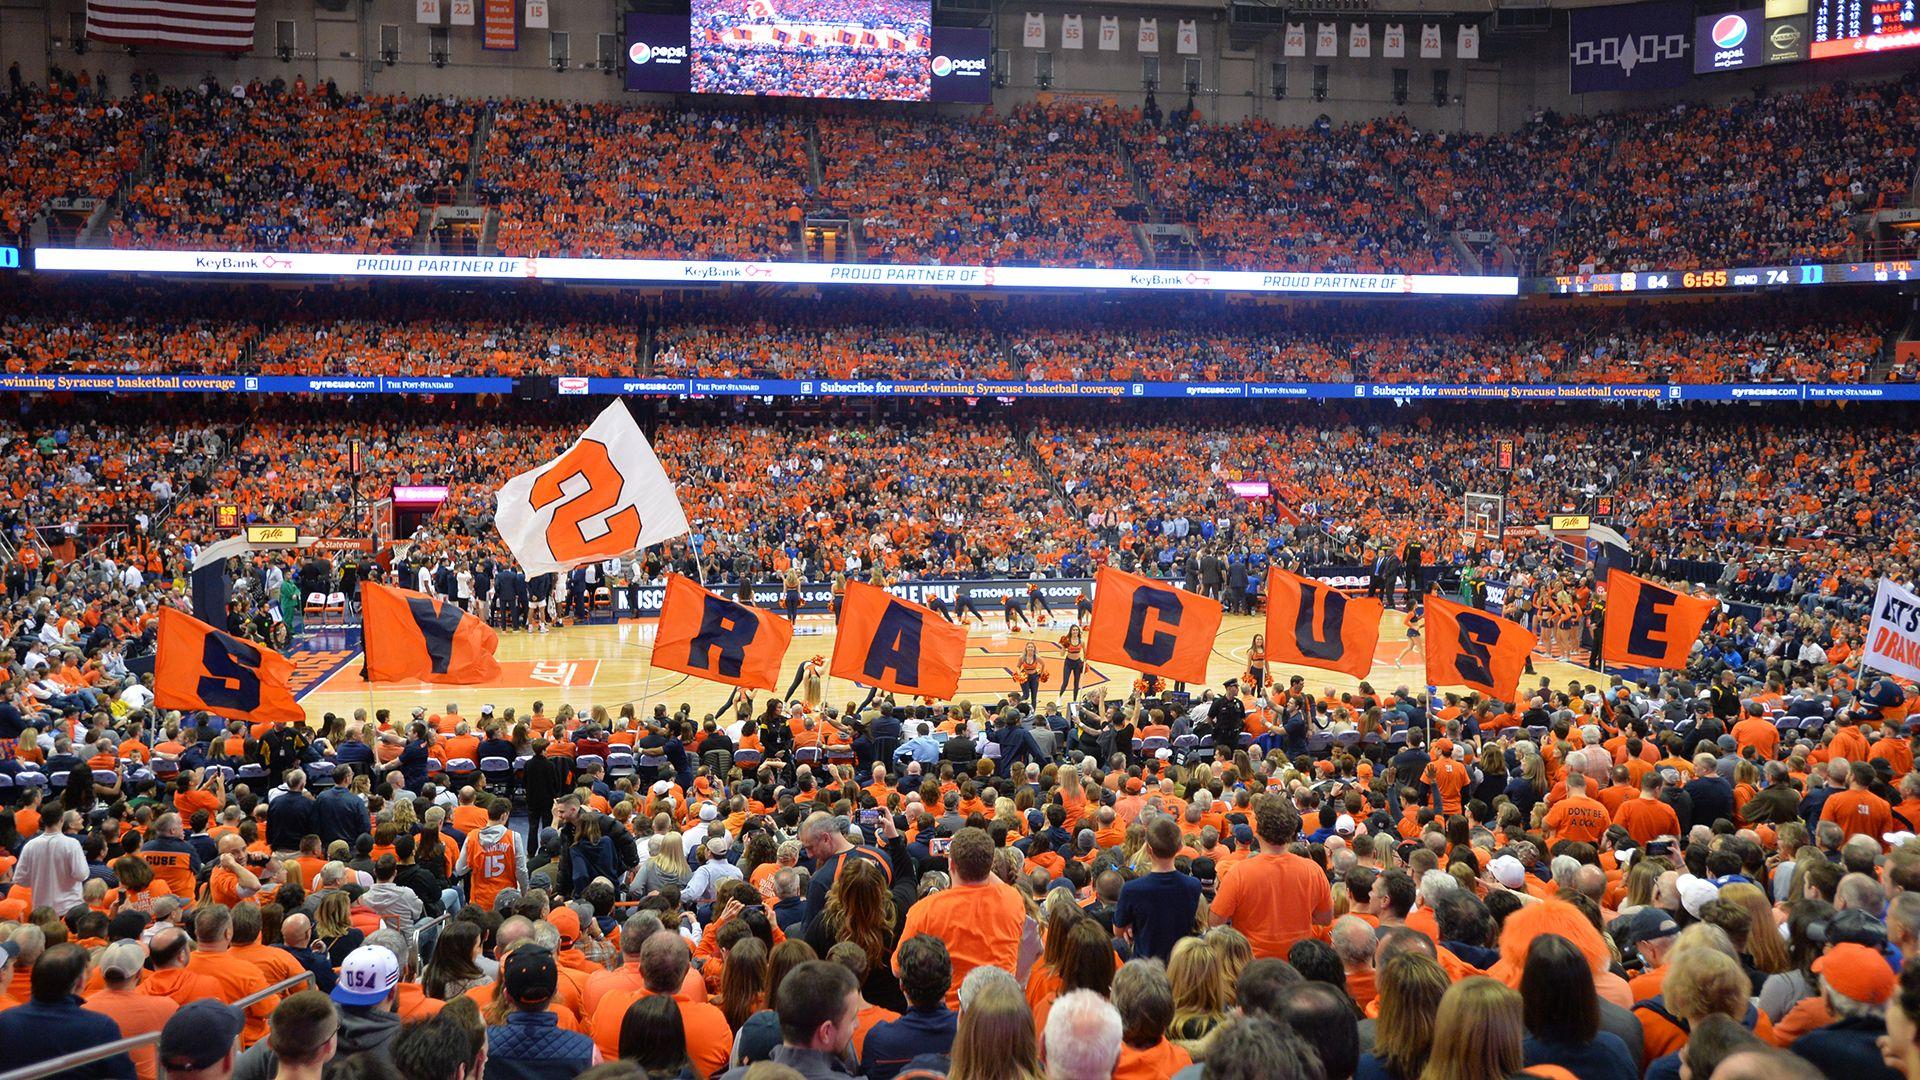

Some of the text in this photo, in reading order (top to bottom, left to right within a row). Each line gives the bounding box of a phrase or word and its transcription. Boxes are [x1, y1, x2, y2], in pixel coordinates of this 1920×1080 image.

[423, 1, 435, 13] 21
[454, 3, 470, 15] 22
[531, 7, 542, 17] 15
[1872, 2, 1900, 13] HALF
[1065, 28, 1079, 39] 55
[1103, 30, 1113, 40] 17
[1141, 32, 1154, 42] 30
[1184, 34, 1191, 44] 4
[1424, 38, 1438, 49] 22
[651, 46, 687, 59] pepsi
[1714, 47, 1745, 61] pepsi
[952, 58, 986, 71] pepsi
[196, 257, 258, 269] KeyBank
[356, 258, 413, 270] PROUD
[417, 259, 494, 272] PARTNER
[498, 261, 520, 273] OF
[684, 266, 741, 278] KeyBank
[831, 267, 881, 279] PROUD
[886, 268, 955, 281] PARTNER
[960, 270, 979, 281] OF
[1767, 271, 1789, 284] 74
[1131, 275, 1182, 286] KeyBank
[1263, 276, 1310, 287] PROUD
[1314, 277, 1377, 289] PARTNER
[1381, 278, 1398, 289] OF
[1683, 271, 1727, 288] 6:55
[58, 377, 114, 390] Syracuse
[117, 377, 179, 388] basketball
[182, 379, 236, 391] coverage
[310, 381, 375, 391] syracuse.com
[387, 380, 454, 389] THE POST-STANDARD
[624, 383, 685, 392] syracuse.com
[696, 383, 710, 391] THE
[820, 382, 873, 393] Subscribe
[876, 382, 894, 393] for
[894, 383, 974, 395] award-winning
[976, 383, 1024, 395] Syracuse
[1026, 383, 1078, 394] basketball
[1080, 385, 1125, 396] coverage
[1186, 386, 1241, 396] syracuse.com
[1264, 387, 1307, 395] POST-STANDARD
[1373, 386, 1420, 396] Subscribe
[1422, 386, 1438, 396] for
[1438, 387, 1509, 398] award-winning
[1511, 387, 1555, 399] Syracuse
[1558, 387, 1611, 397] basketball
[1614, 388, 1660, 399] coverage
[1732, 388, 1797, 398] syracuse.com
[1810, 388, 1883, 396] THE POST-STANDARD
[1500, 453, 1510, 468] 30
[260, 529, 282, 541] Pella
[732, 592, 778, 602] SONG
[970, 588, 1013, 599] STRONG
[1015, 587, 1048, 598] FES
[1049, 586, 1081, 597] GOOD
[1123, 585, 1184, 667] C
[1294, 583, 1349, 662] U
[1627, 583, 1678, 659] E
[406, 597, 464, 674] Y
[687, 594, 760, 678] R
[863, 600, 923, 688] A
[1454, 611, 1502, 688] S
[197, 631, 262, 713] S
[1568, 808, 1602, 818] DON'T BE
[145, 856, 177, 866] CUSE
[484, 854, 505, 878] 15
[346, 971, 377, 989] USA
